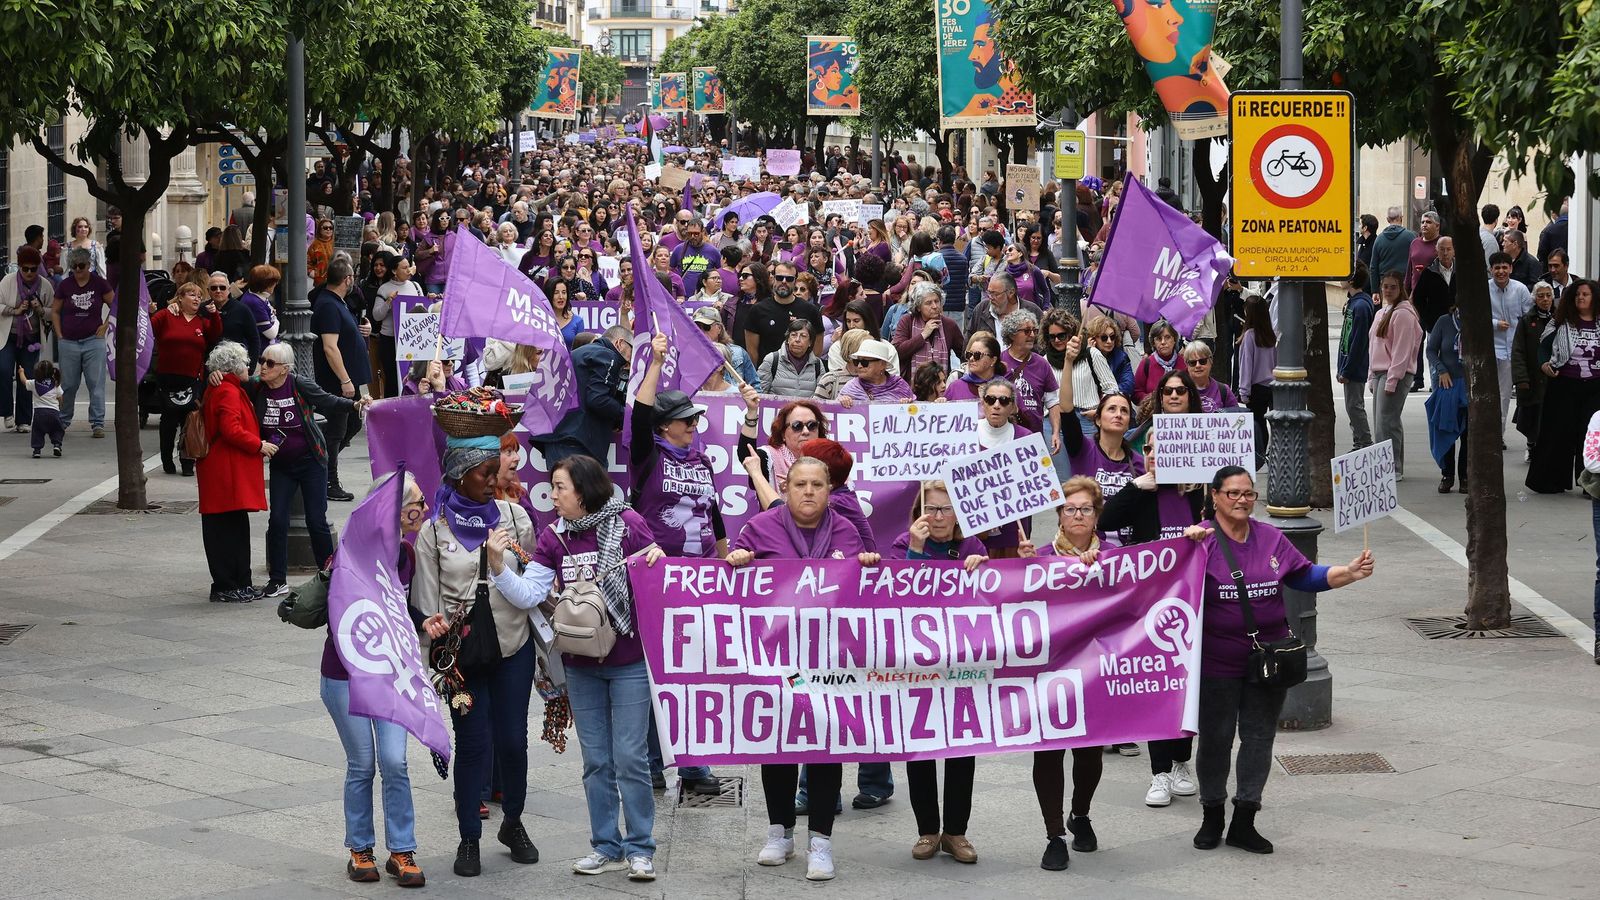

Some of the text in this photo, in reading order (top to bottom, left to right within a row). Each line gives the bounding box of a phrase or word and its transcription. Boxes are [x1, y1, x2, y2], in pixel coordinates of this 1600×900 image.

[942, 25, 963, 33] TIVAL
[841, 43, 857, 56] 30
[942, 39, 968, 47] JEREZ
[1241, 219, 1343, 233] ZONA PEATONAL
[1238, 246, 1288, 255] ORDENANZA
[1289, 246, 1332, 255] MUNICIPAL
[1264, 254, 1320, 264] CIRCULACIÓN
[1275, 264, 1288, 272] Art.
[1302, 264, 1309, 272] A
[399, 313, 438, 346] MALTRATADO
[1192, 417, 1203, 429] DE
[1206, 417, 1230, 429] UNA
[1156, 430, 1183, 441] GRAN
[1217, 430, 1236, 440] HAY
[1238, 429, 1252, 440] UN
[1157, 442, 1252, 454] ACOMPLEJAO QUE LA
[951, 444, 1039, 484] APARENTA EN
[1338, 445, 1393, 477] TE CANSAS
[954, 460, 1039, 500] LA CALLE LO
[1345, 472, 1359, 492] DE
[959, 473, 1052, 515] QUE NO ERES
[1339, 478, 1393, 510] NOSOTRAS
[966, 493, 1050, 529] EN LA CASA
[1339, 495, 1397, 528] DE VIVIRLO
[663, 547, 1178, 599] FRENTE AL FASCISMO DESATADO
[1219, 587, 1278, 599] ELIS ESPEJO
[667, 606, 1046, 671] FEMINISMO
[947, 669, 987, 681] LIBRE
[1099, 654, 1167, 678] Marea
[1105, 677, 1160, 697] Violeta
[657, 676, 1080, 747] ORGANIZADO
